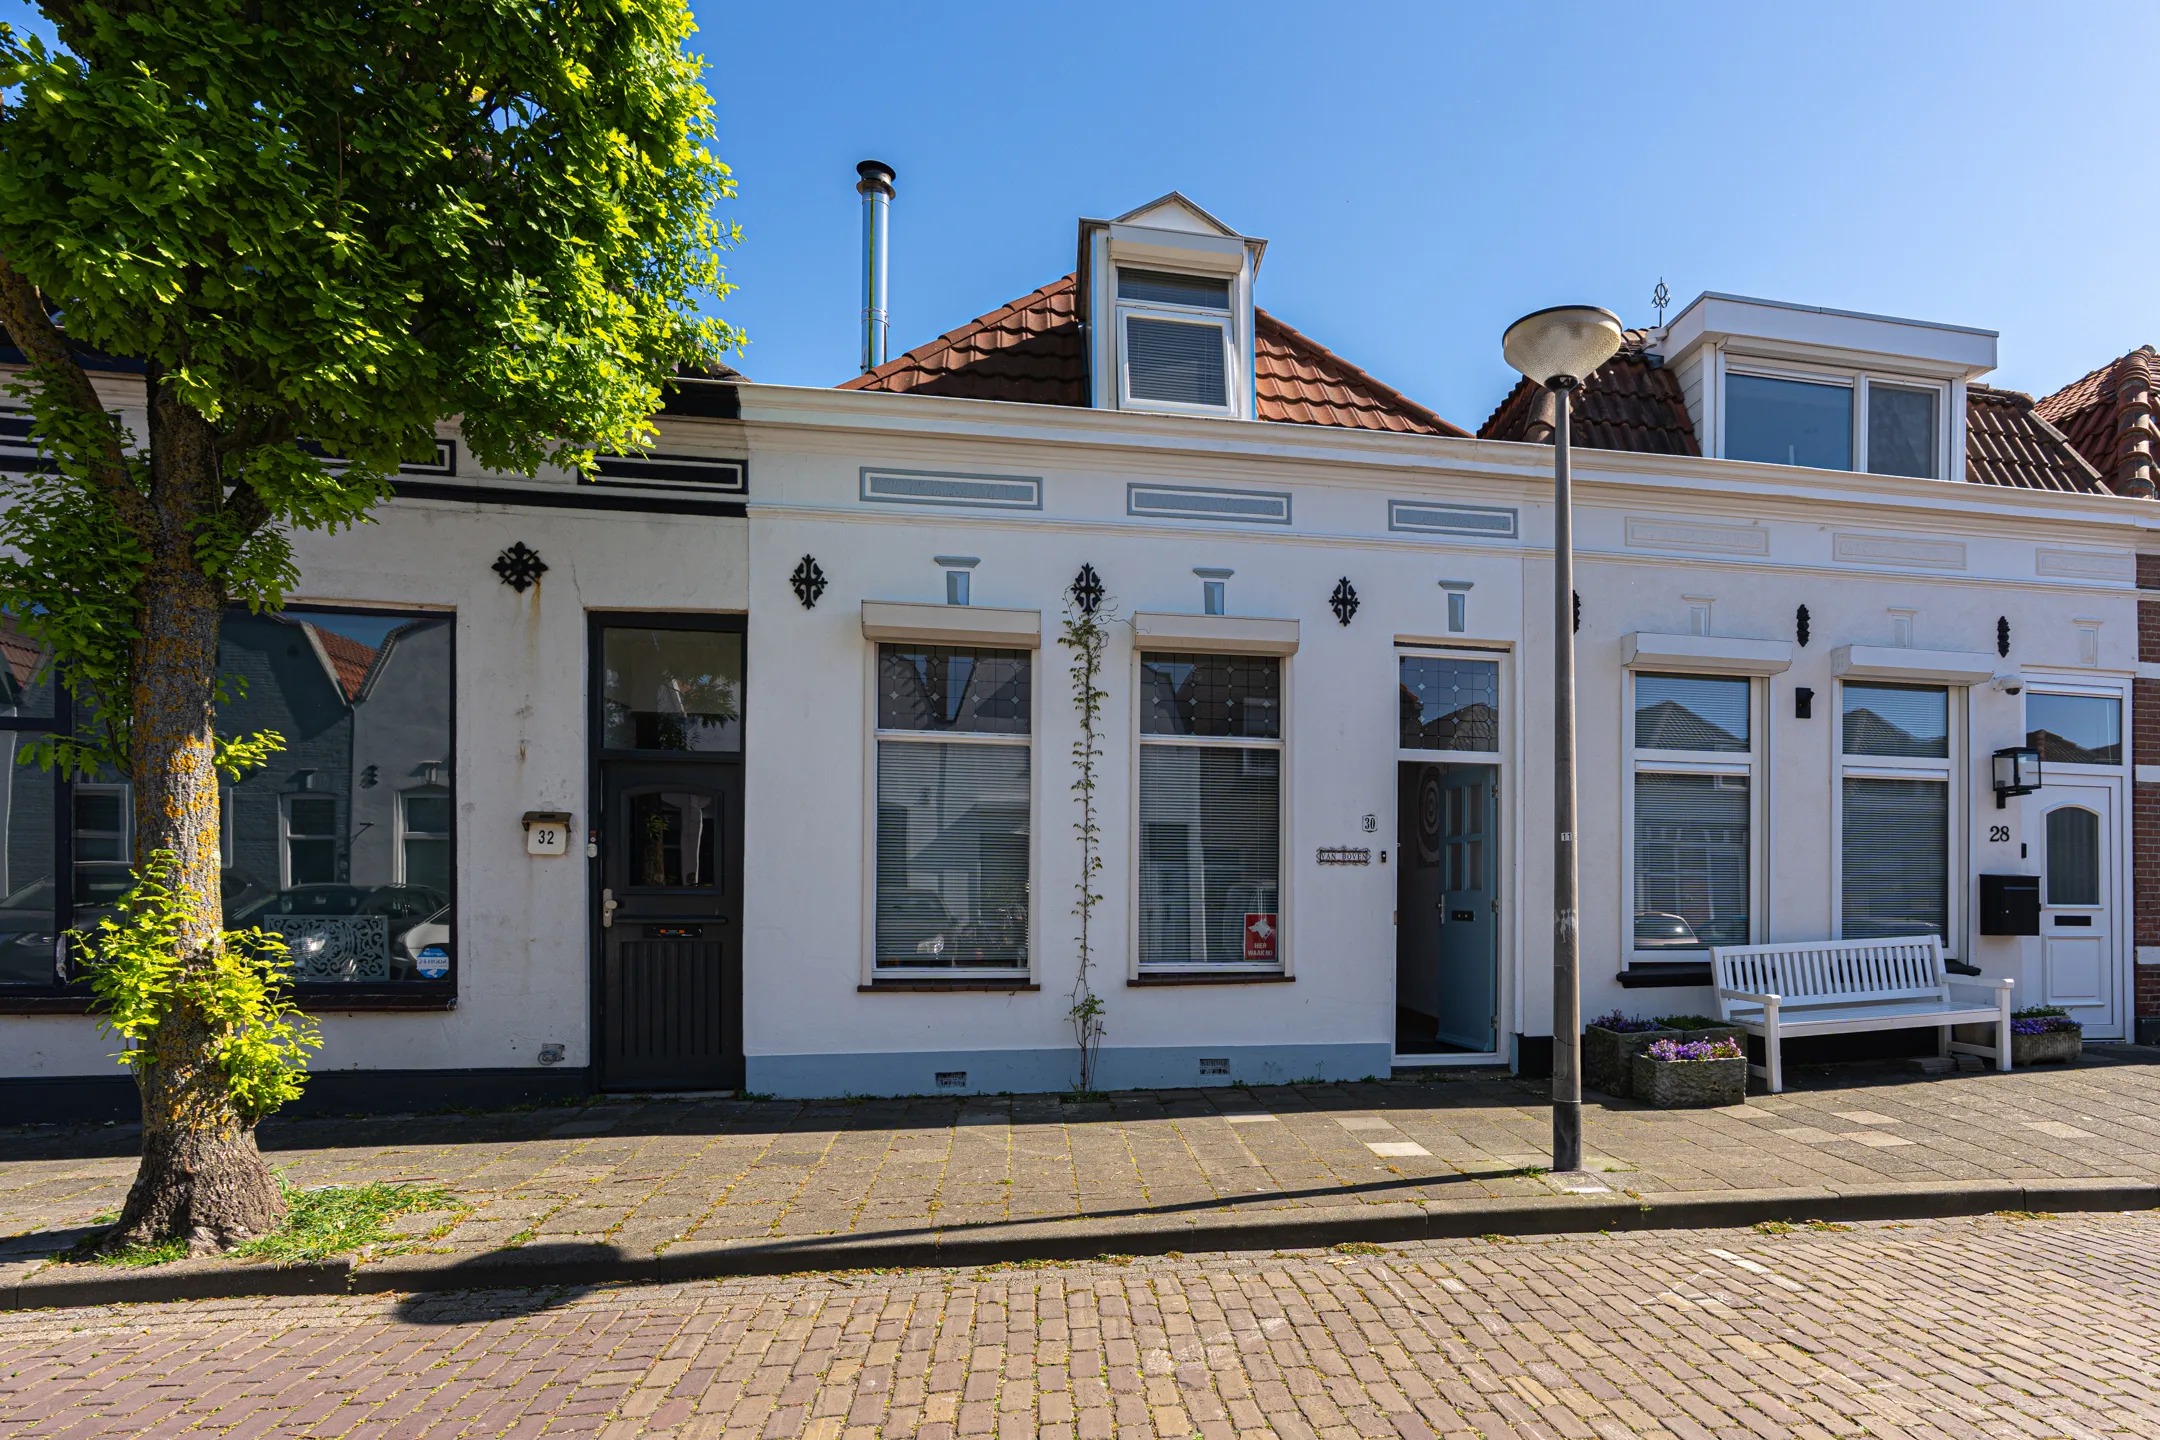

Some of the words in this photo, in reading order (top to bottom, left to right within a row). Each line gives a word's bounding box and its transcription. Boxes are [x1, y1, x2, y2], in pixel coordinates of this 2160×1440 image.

[1364, 817, 1376, 830] 30
[538, 829, 554, 845] 32
[1989, 825, 2010, 842] 28
